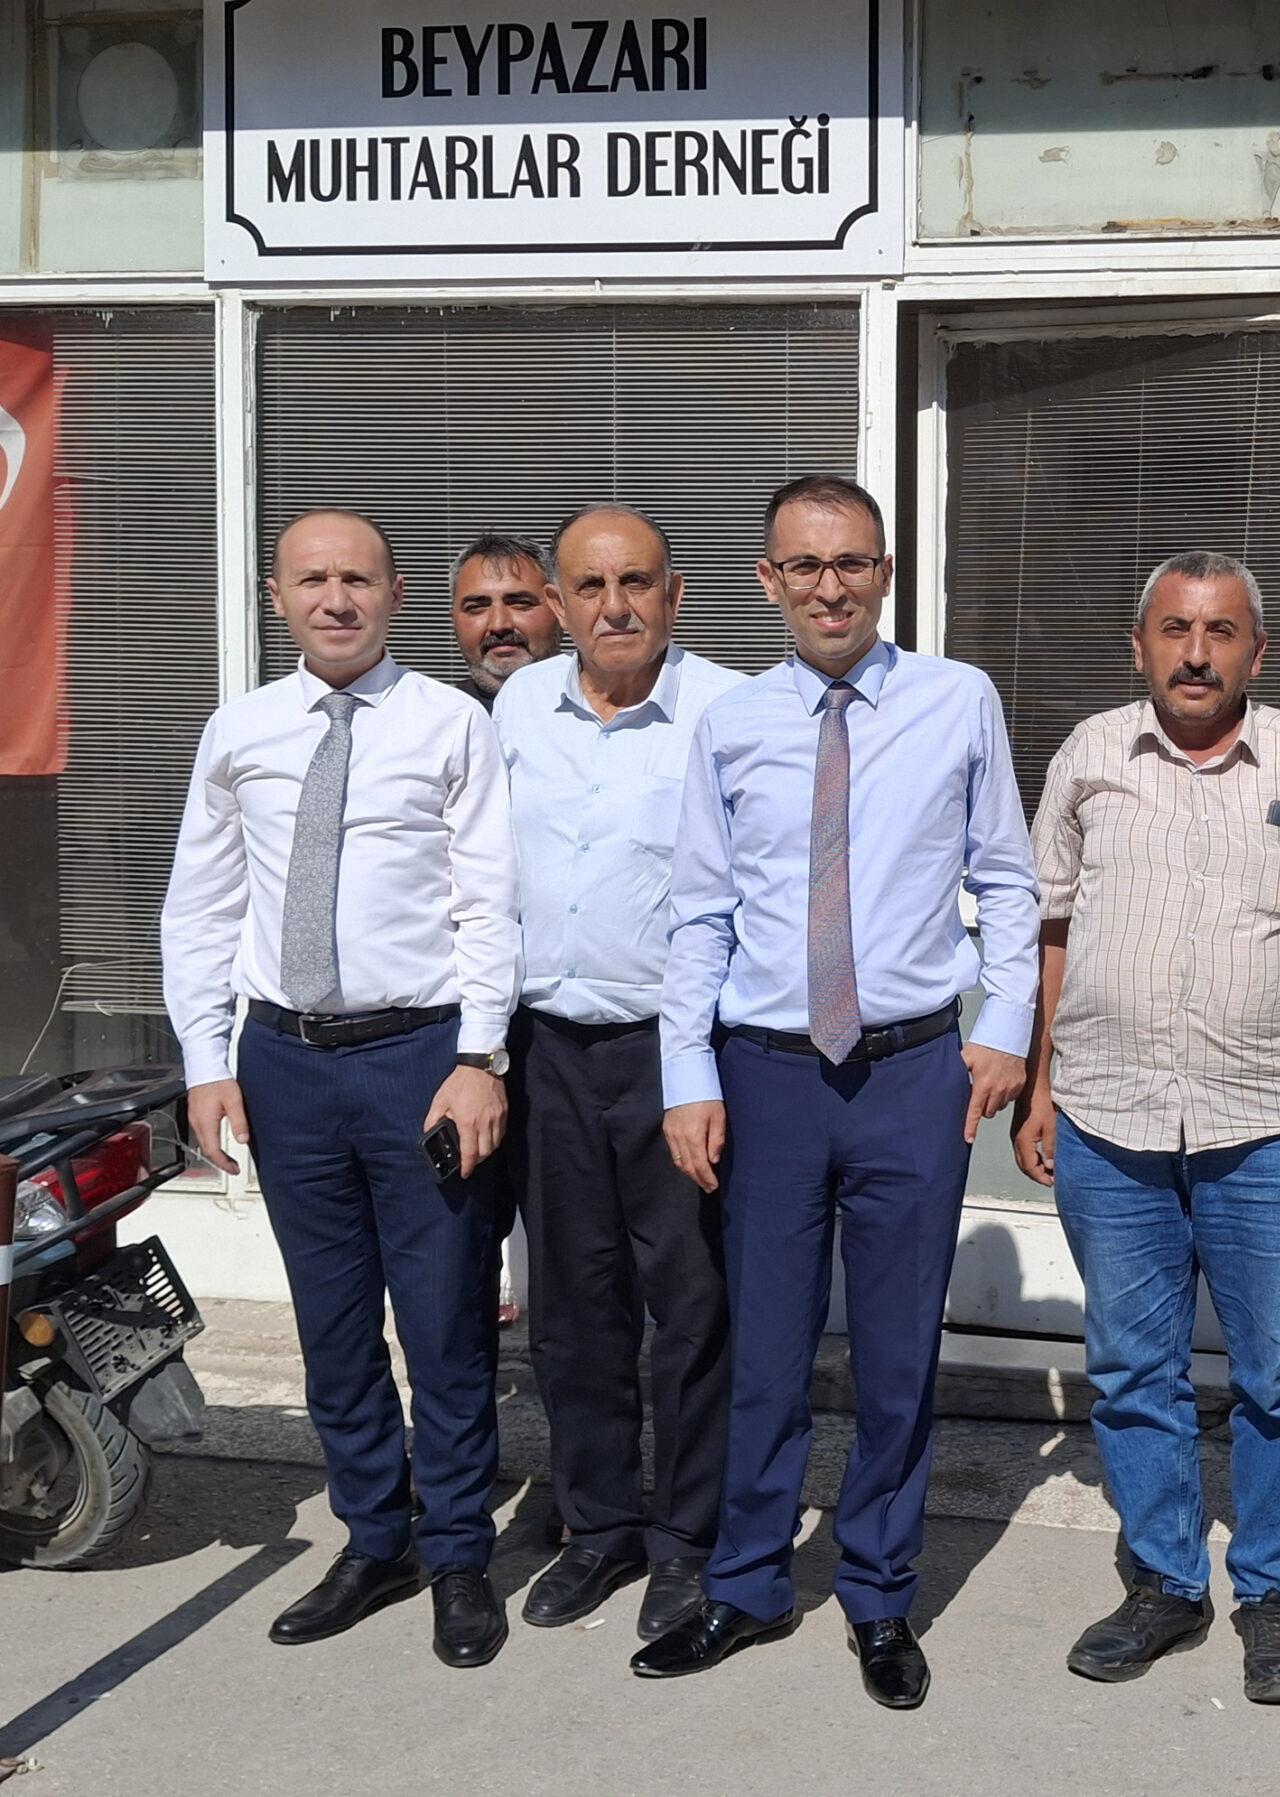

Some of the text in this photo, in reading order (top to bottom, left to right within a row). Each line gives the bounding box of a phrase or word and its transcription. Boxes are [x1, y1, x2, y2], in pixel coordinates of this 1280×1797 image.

[380, 17, 708, 98] BEYPAZARI
[266, 113, 830, 203] MUHTARLAR DERNEĞİ
